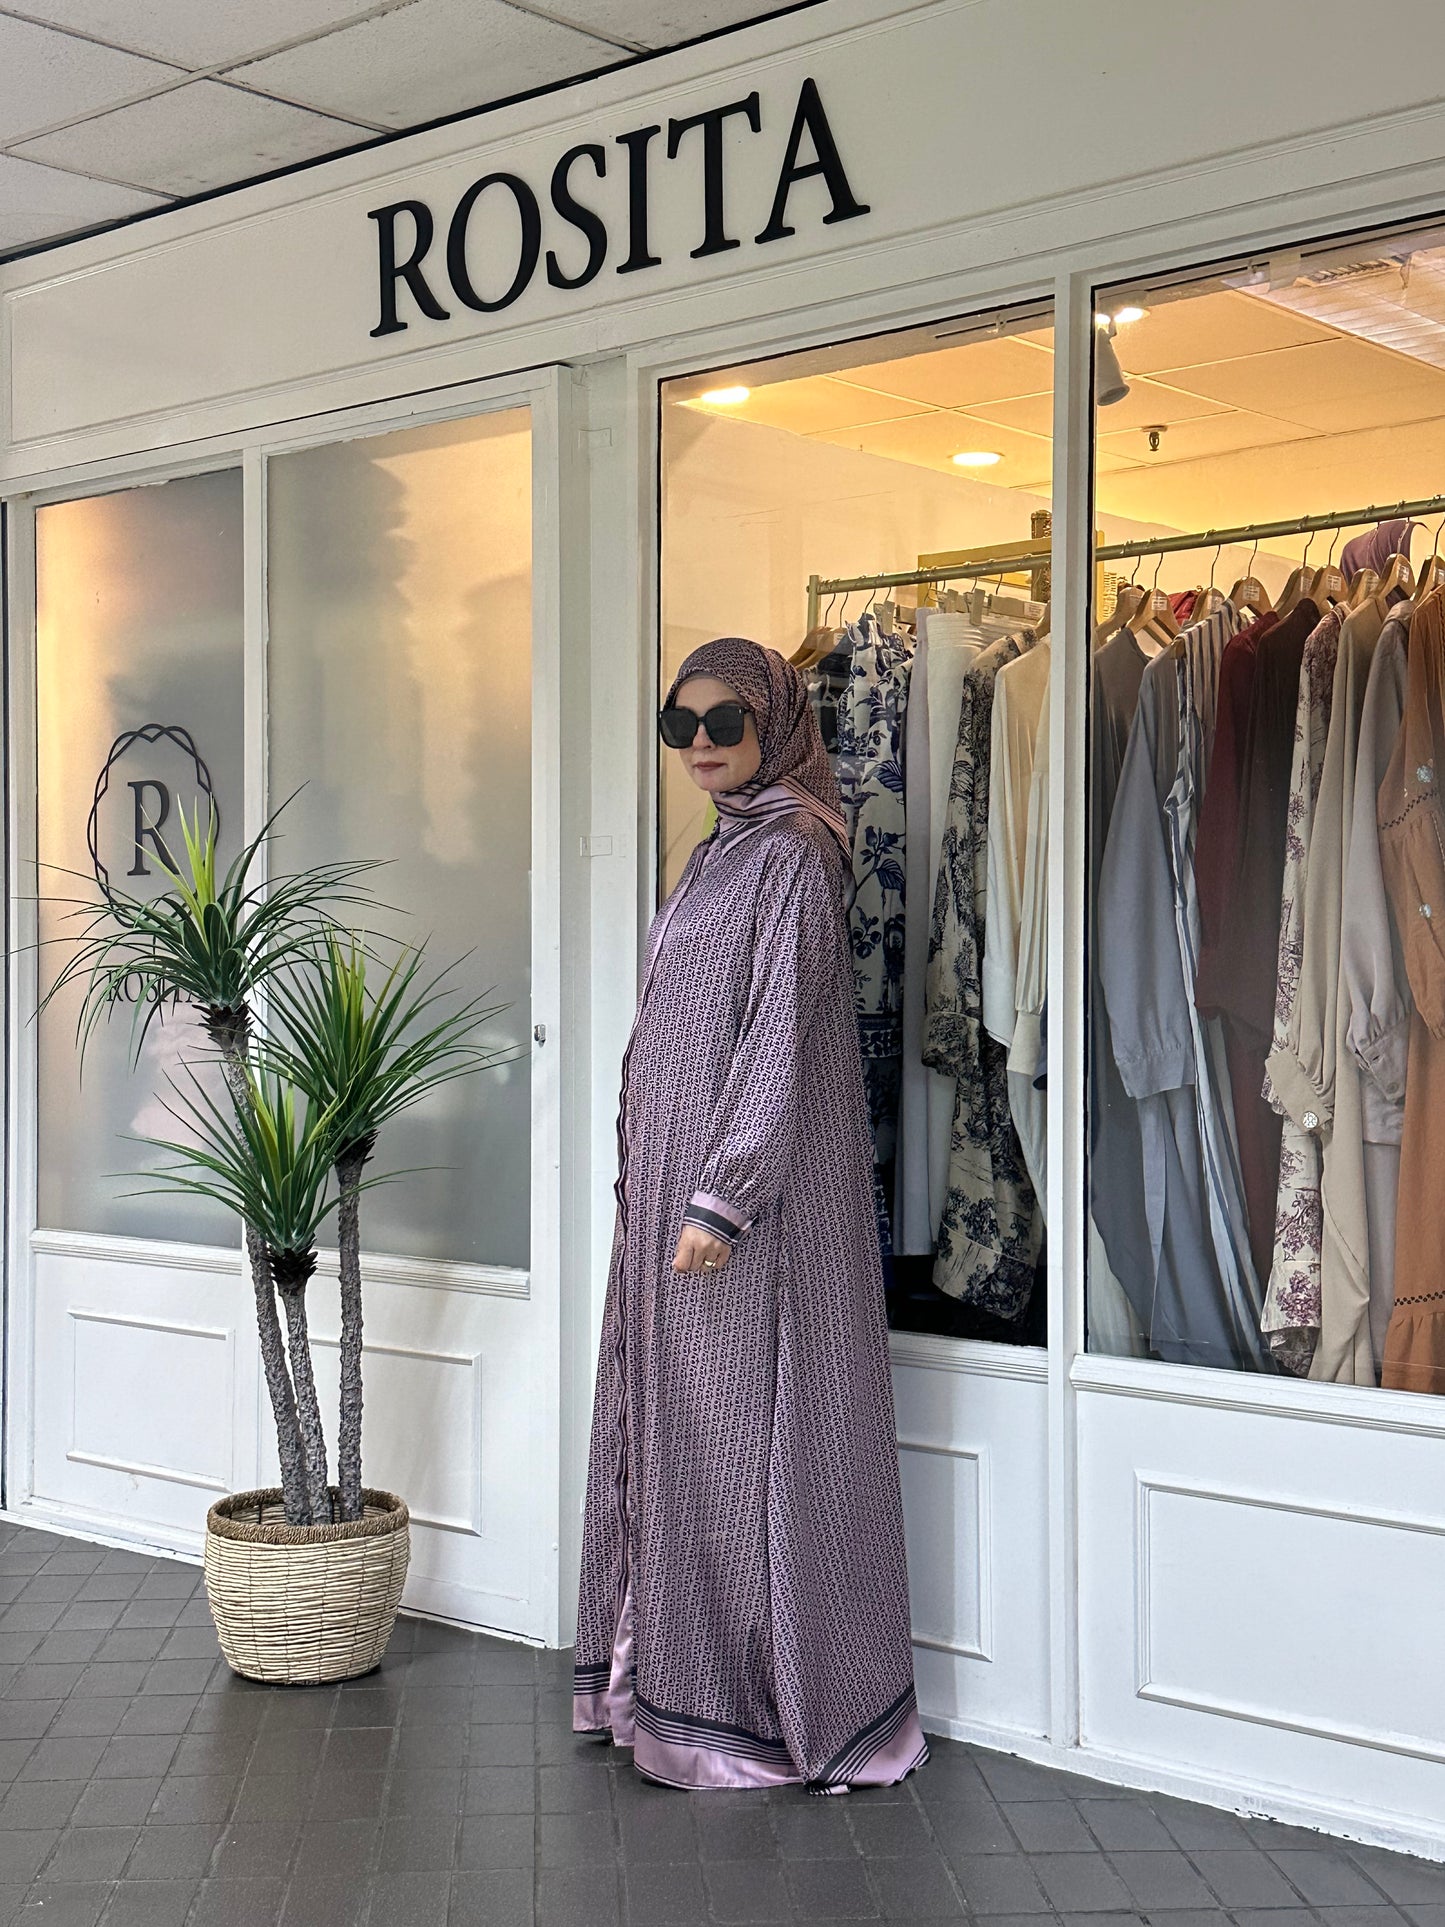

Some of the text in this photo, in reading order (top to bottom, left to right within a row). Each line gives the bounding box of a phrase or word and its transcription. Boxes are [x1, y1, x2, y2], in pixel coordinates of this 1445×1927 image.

[369, 77, 871, 338] ROSITA
[127, 780, 180, 876] R
[106, 970, 206, 1003] ROSI
